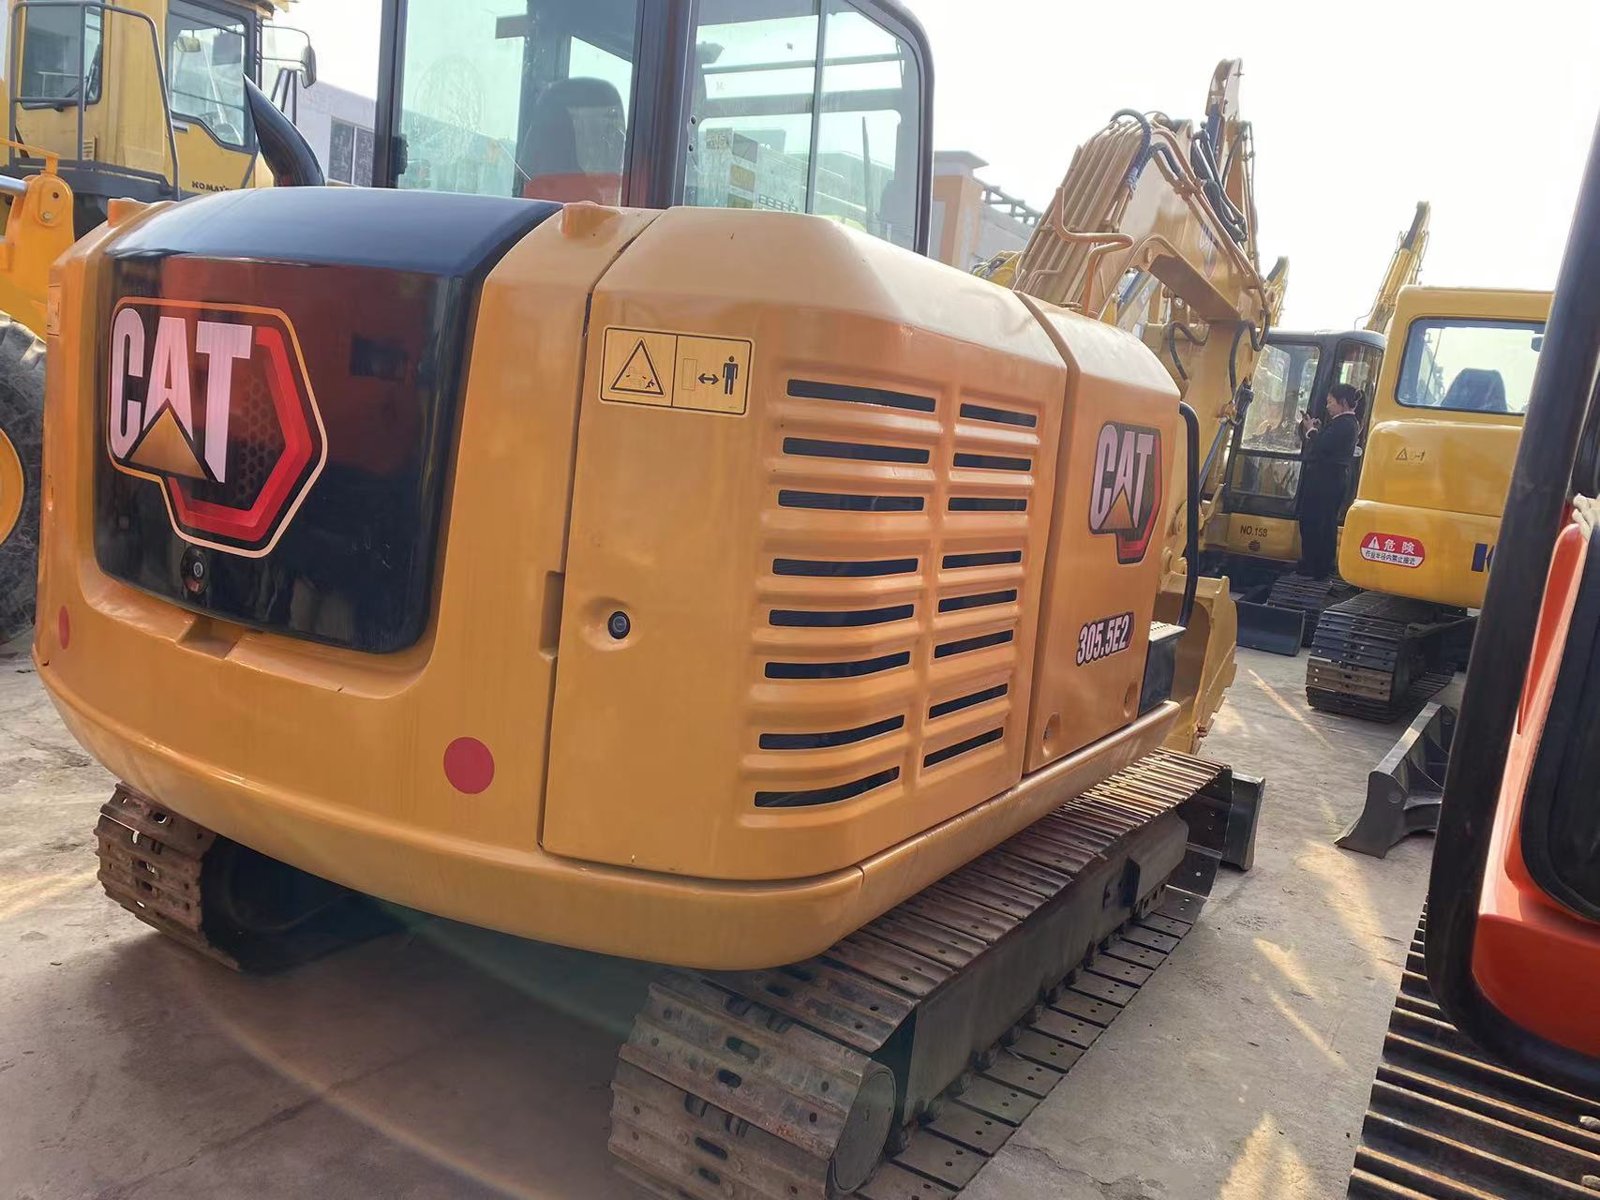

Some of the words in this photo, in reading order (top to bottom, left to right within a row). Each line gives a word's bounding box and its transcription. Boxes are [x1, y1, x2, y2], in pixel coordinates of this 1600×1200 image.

[110, 307, 253, 484] CAT
[1090, 424, 1154, 530] CAT
[1077, 613, 1131, 665] 305.5E2
